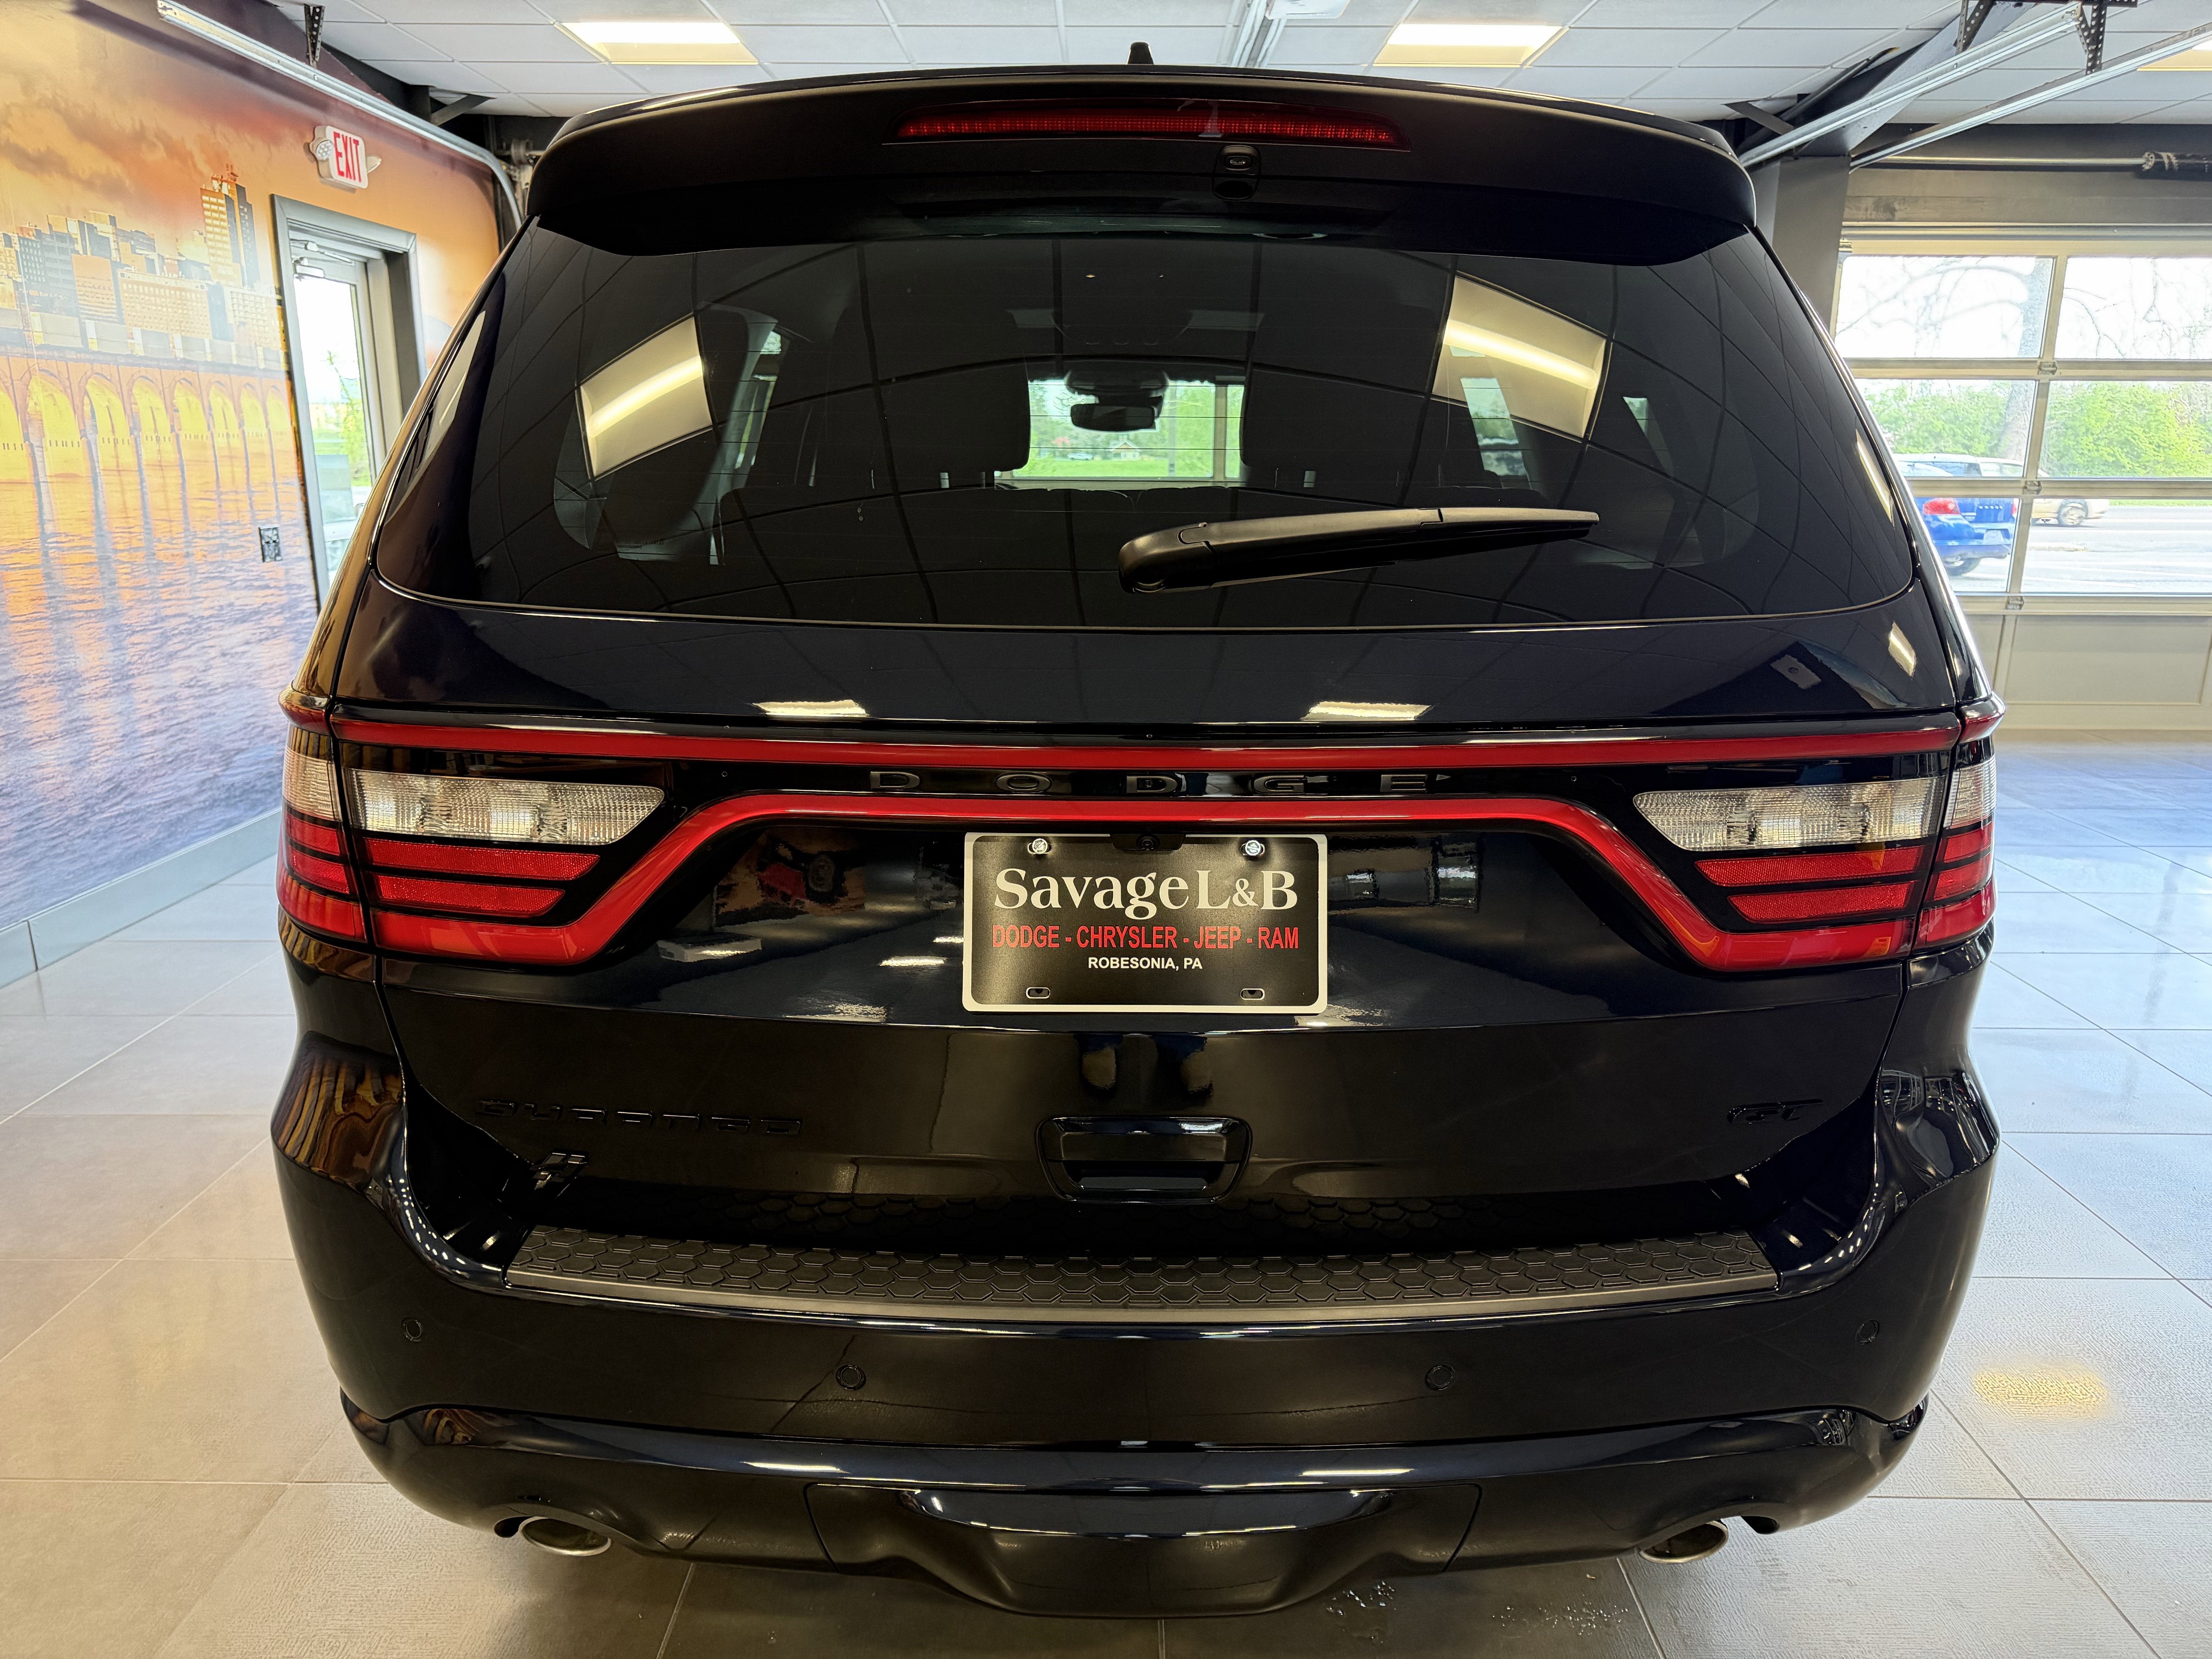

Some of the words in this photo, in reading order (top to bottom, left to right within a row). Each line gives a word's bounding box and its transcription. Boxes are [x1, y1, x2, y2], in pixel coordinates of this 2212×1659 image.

[333, 132, 362, 182] EXIT
[870, 771, 1428, 794] DODGE
[994, 869, 1188, 921] Savage
[993, 926, 1059, 948] DODGE
[1077, 926, 1177, 948] CHRYSLER
[1194, 927, 1240, 948] JEEP
[1259, 927, 1298, 948] RAM
[1089, 957, 1178, 970] ROBESONIA,
[1184, 958, 1202, 969] PA
[475, 1097, 803, 1135] DURANGO
[1727, 1098, 1824, 1125] GT
